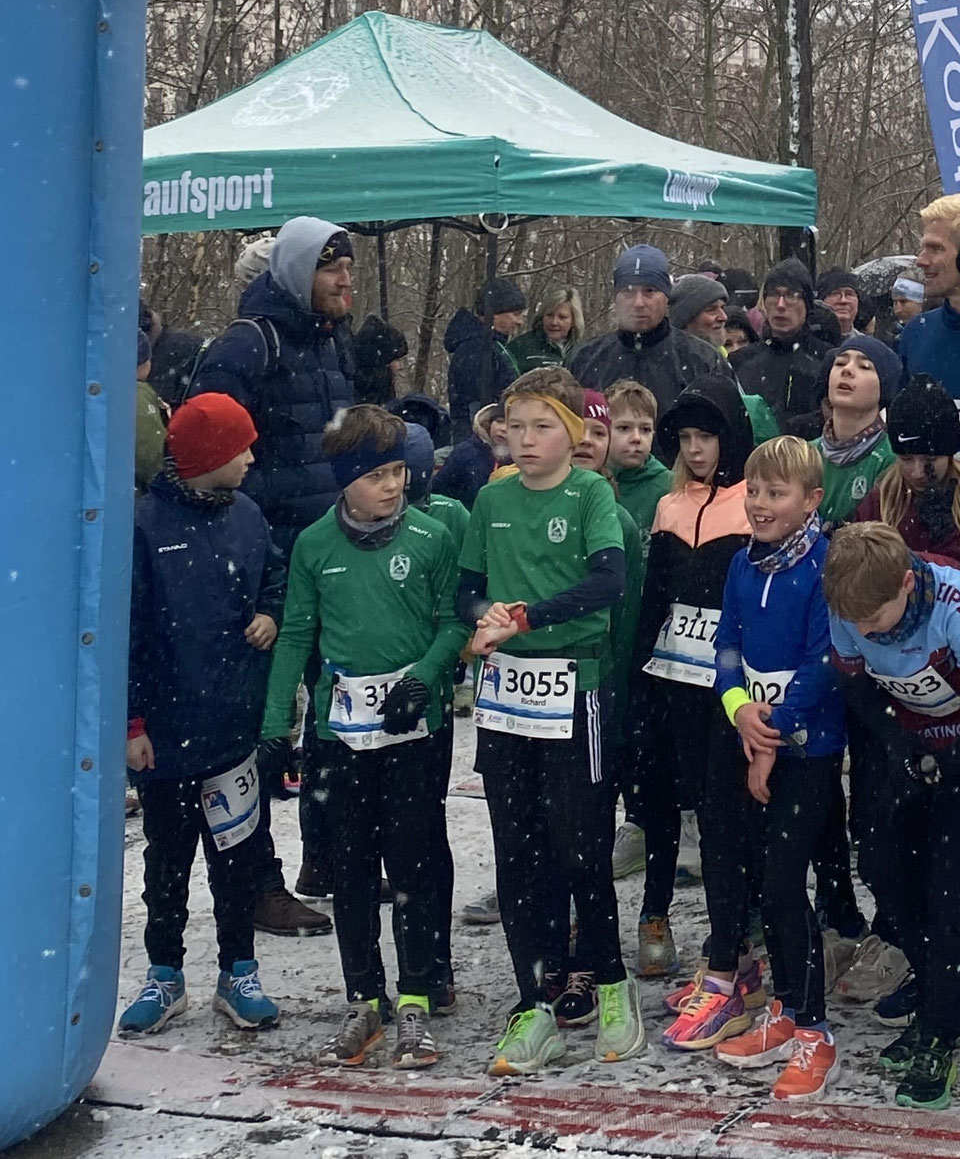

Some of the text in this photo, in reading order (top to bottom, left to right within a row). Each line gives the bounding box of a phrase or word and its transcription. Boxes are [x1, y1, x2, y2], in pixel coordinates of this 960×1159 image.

[143, 167, 275, 220] aufsport
[674, 615, 721, 643] 3117
[505, 668, 569, 697] 3055
[520, 697, 547, 707] Richard
